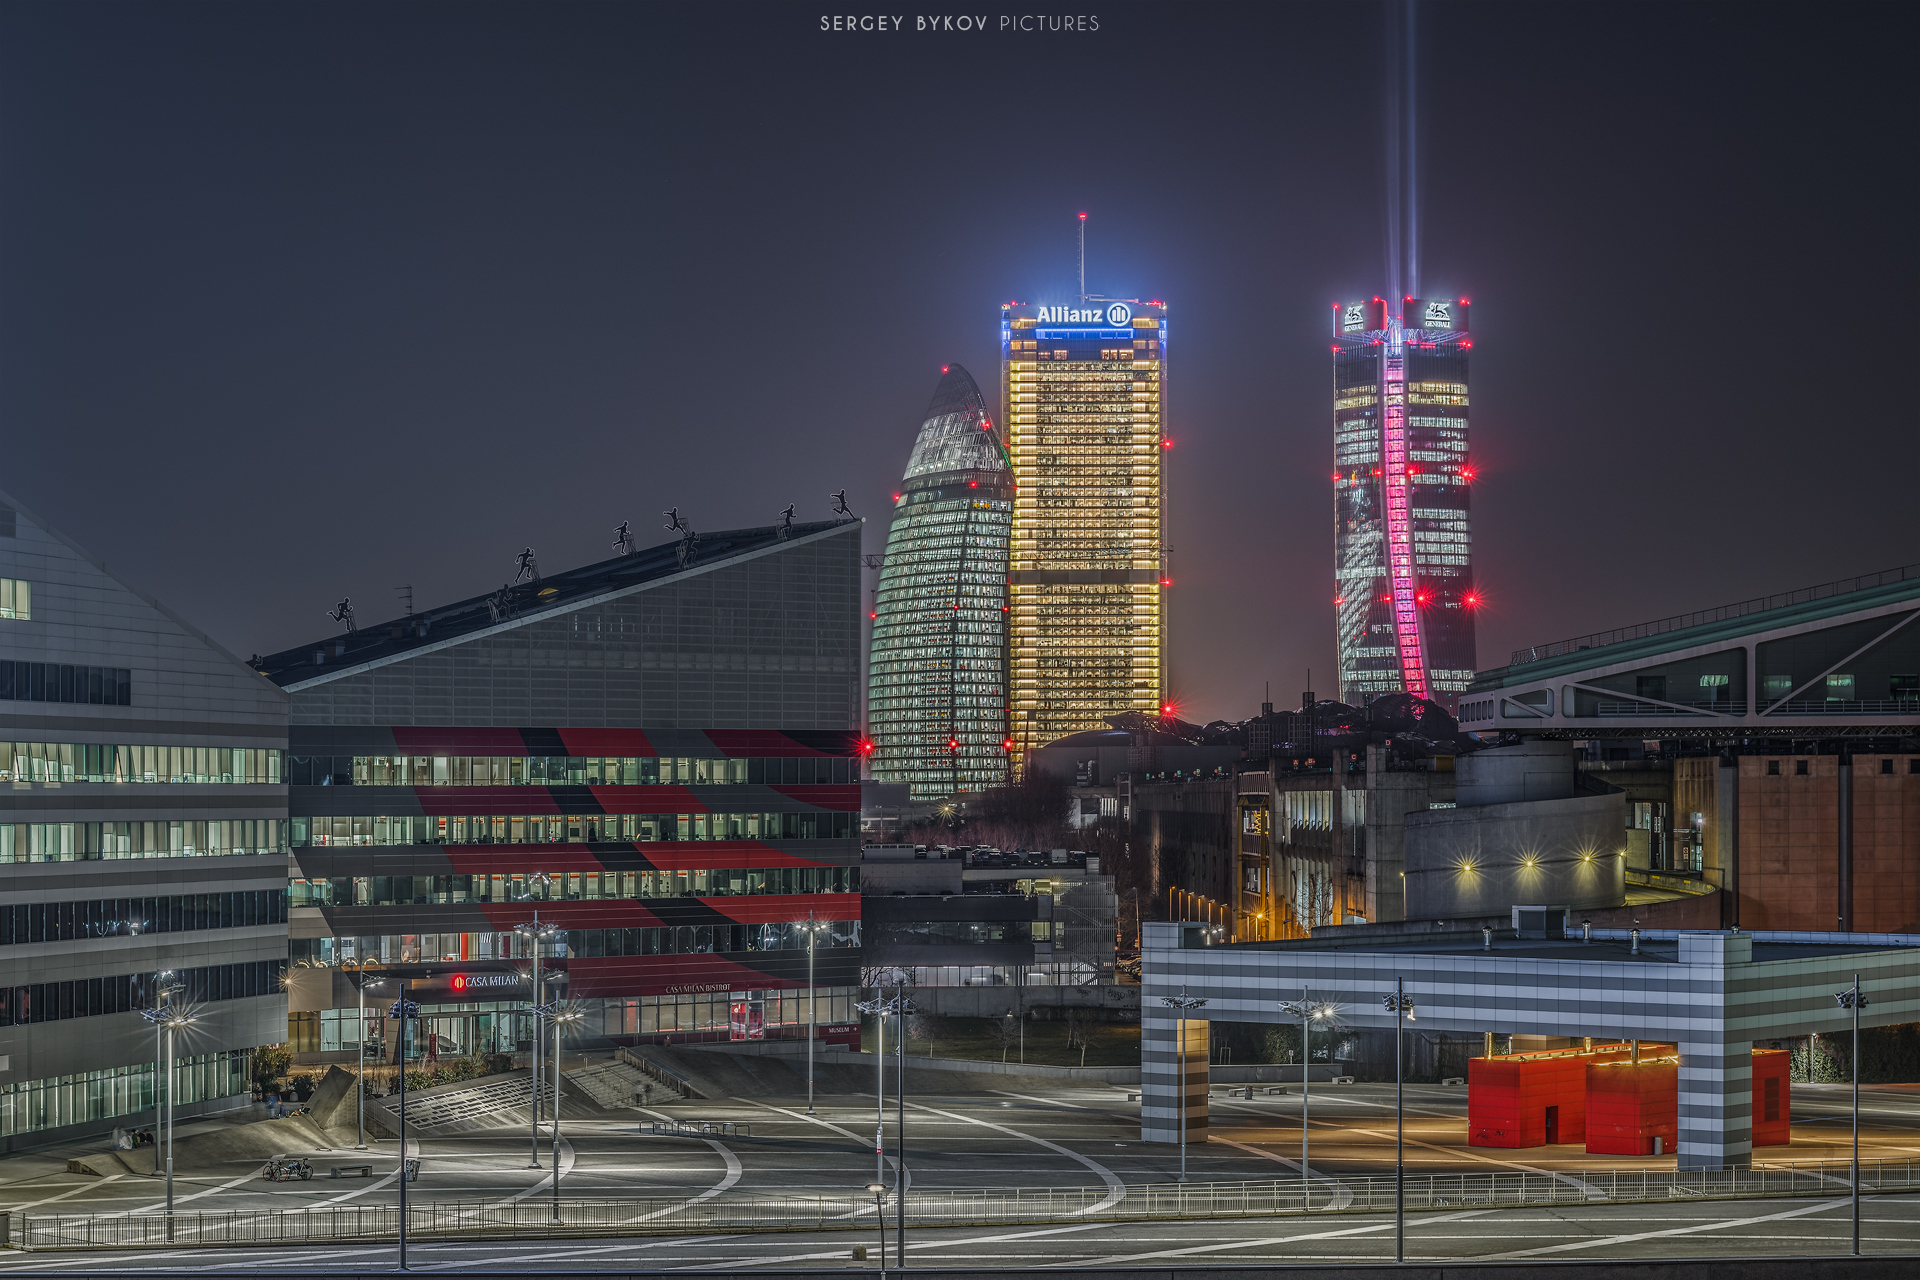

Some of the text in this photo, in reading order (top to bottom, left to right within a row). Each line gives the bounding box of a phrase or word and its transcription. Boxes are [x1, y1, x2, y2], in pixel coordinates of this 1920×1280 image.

[1036, 306, 1103, 323] Allianz
[1425, 320, 1451, 328] GENERALI
[465, 975, 519, 987] CASA MILAN
[665, 983, 731, 994] CASA MILAN BISTROT
[828, 1026, 850, 1034] MUSEUM
